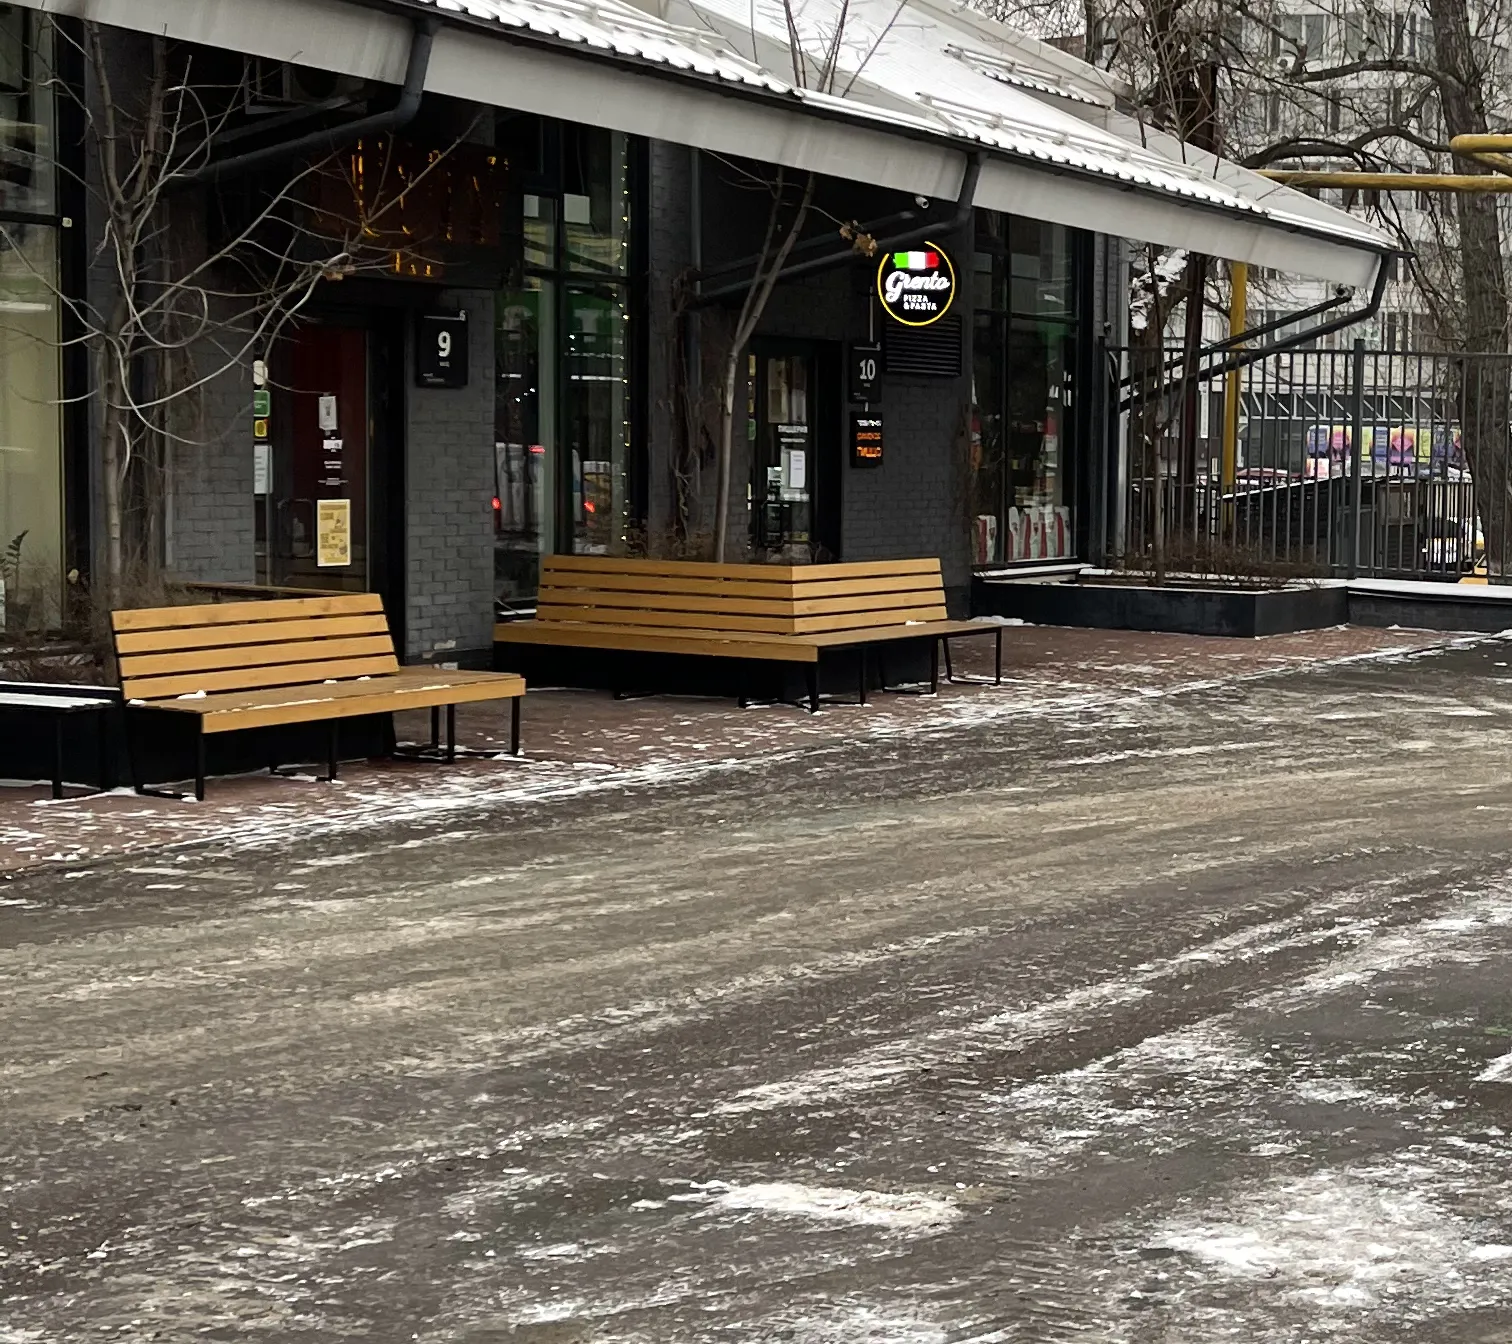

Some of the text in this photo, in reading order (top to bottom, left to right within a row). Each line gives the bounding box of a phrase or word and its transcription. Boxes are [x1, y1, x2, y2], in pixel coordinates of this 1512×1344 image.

[903, 294, 929, 303] PIZZA
[437, 331, 452, 358] 9
[859, 358, 876, 381] 10
